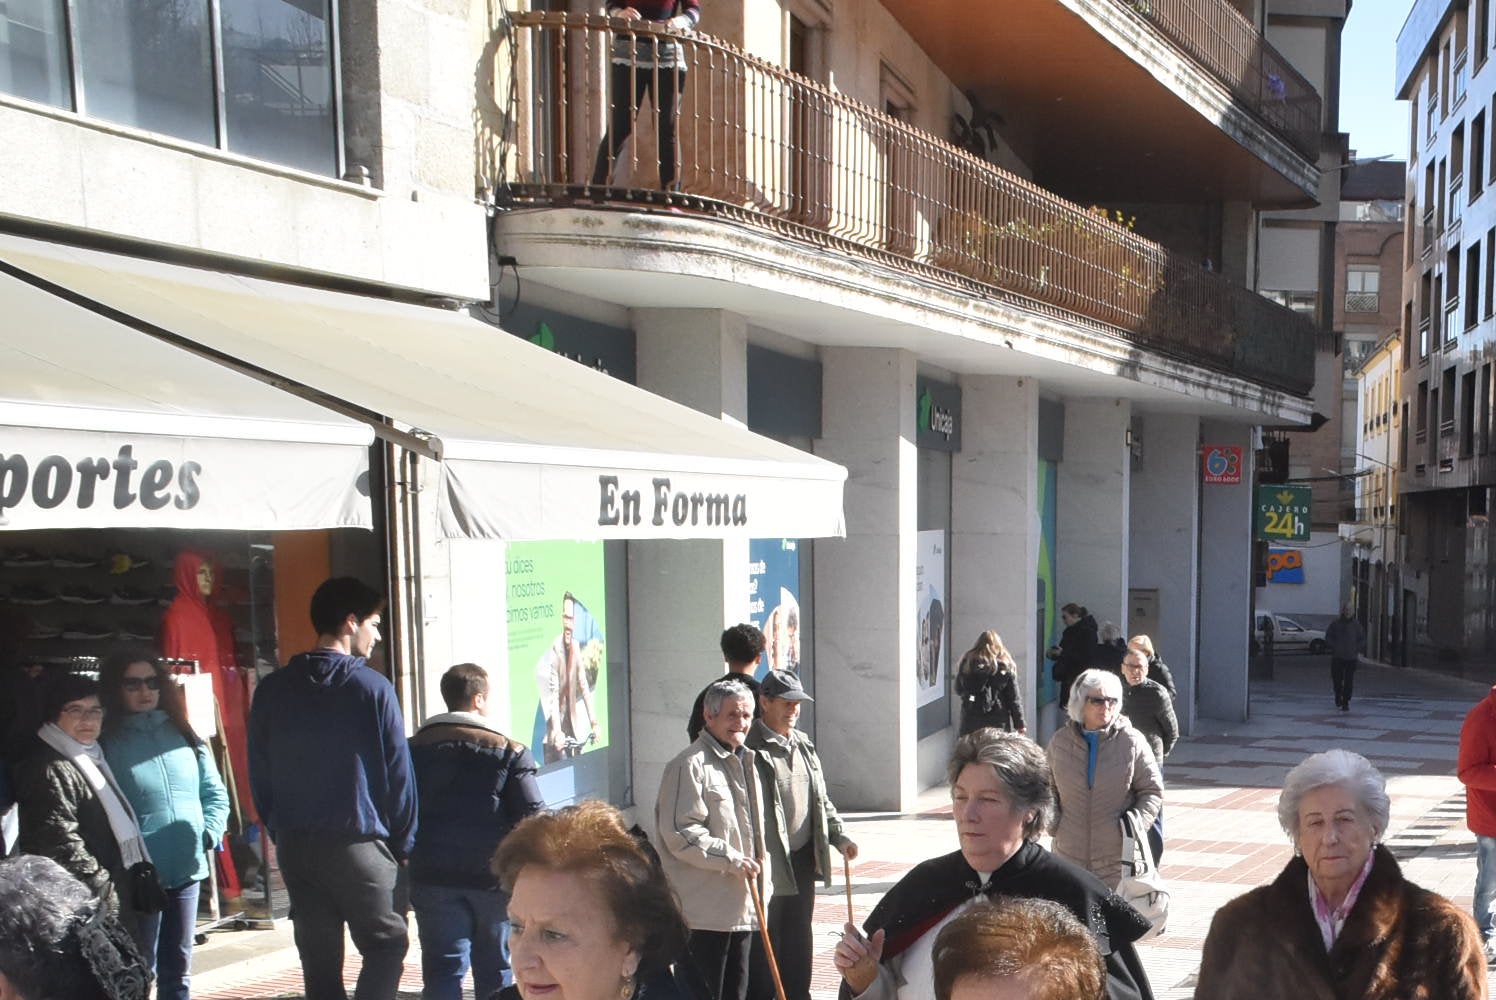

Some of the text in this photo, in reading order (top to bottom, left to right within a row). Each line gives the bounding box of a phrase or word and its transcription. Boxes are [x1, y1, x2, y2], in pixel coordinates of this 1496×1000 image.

[931, 404, 953, 441] Unicaja
[597, 475, 748, 526] En Forma
[1261, 505, 1308, 514] CAJERO
[1264, 512, 1304, 538] 24h
[511, 581, 546, 598] nosotros
